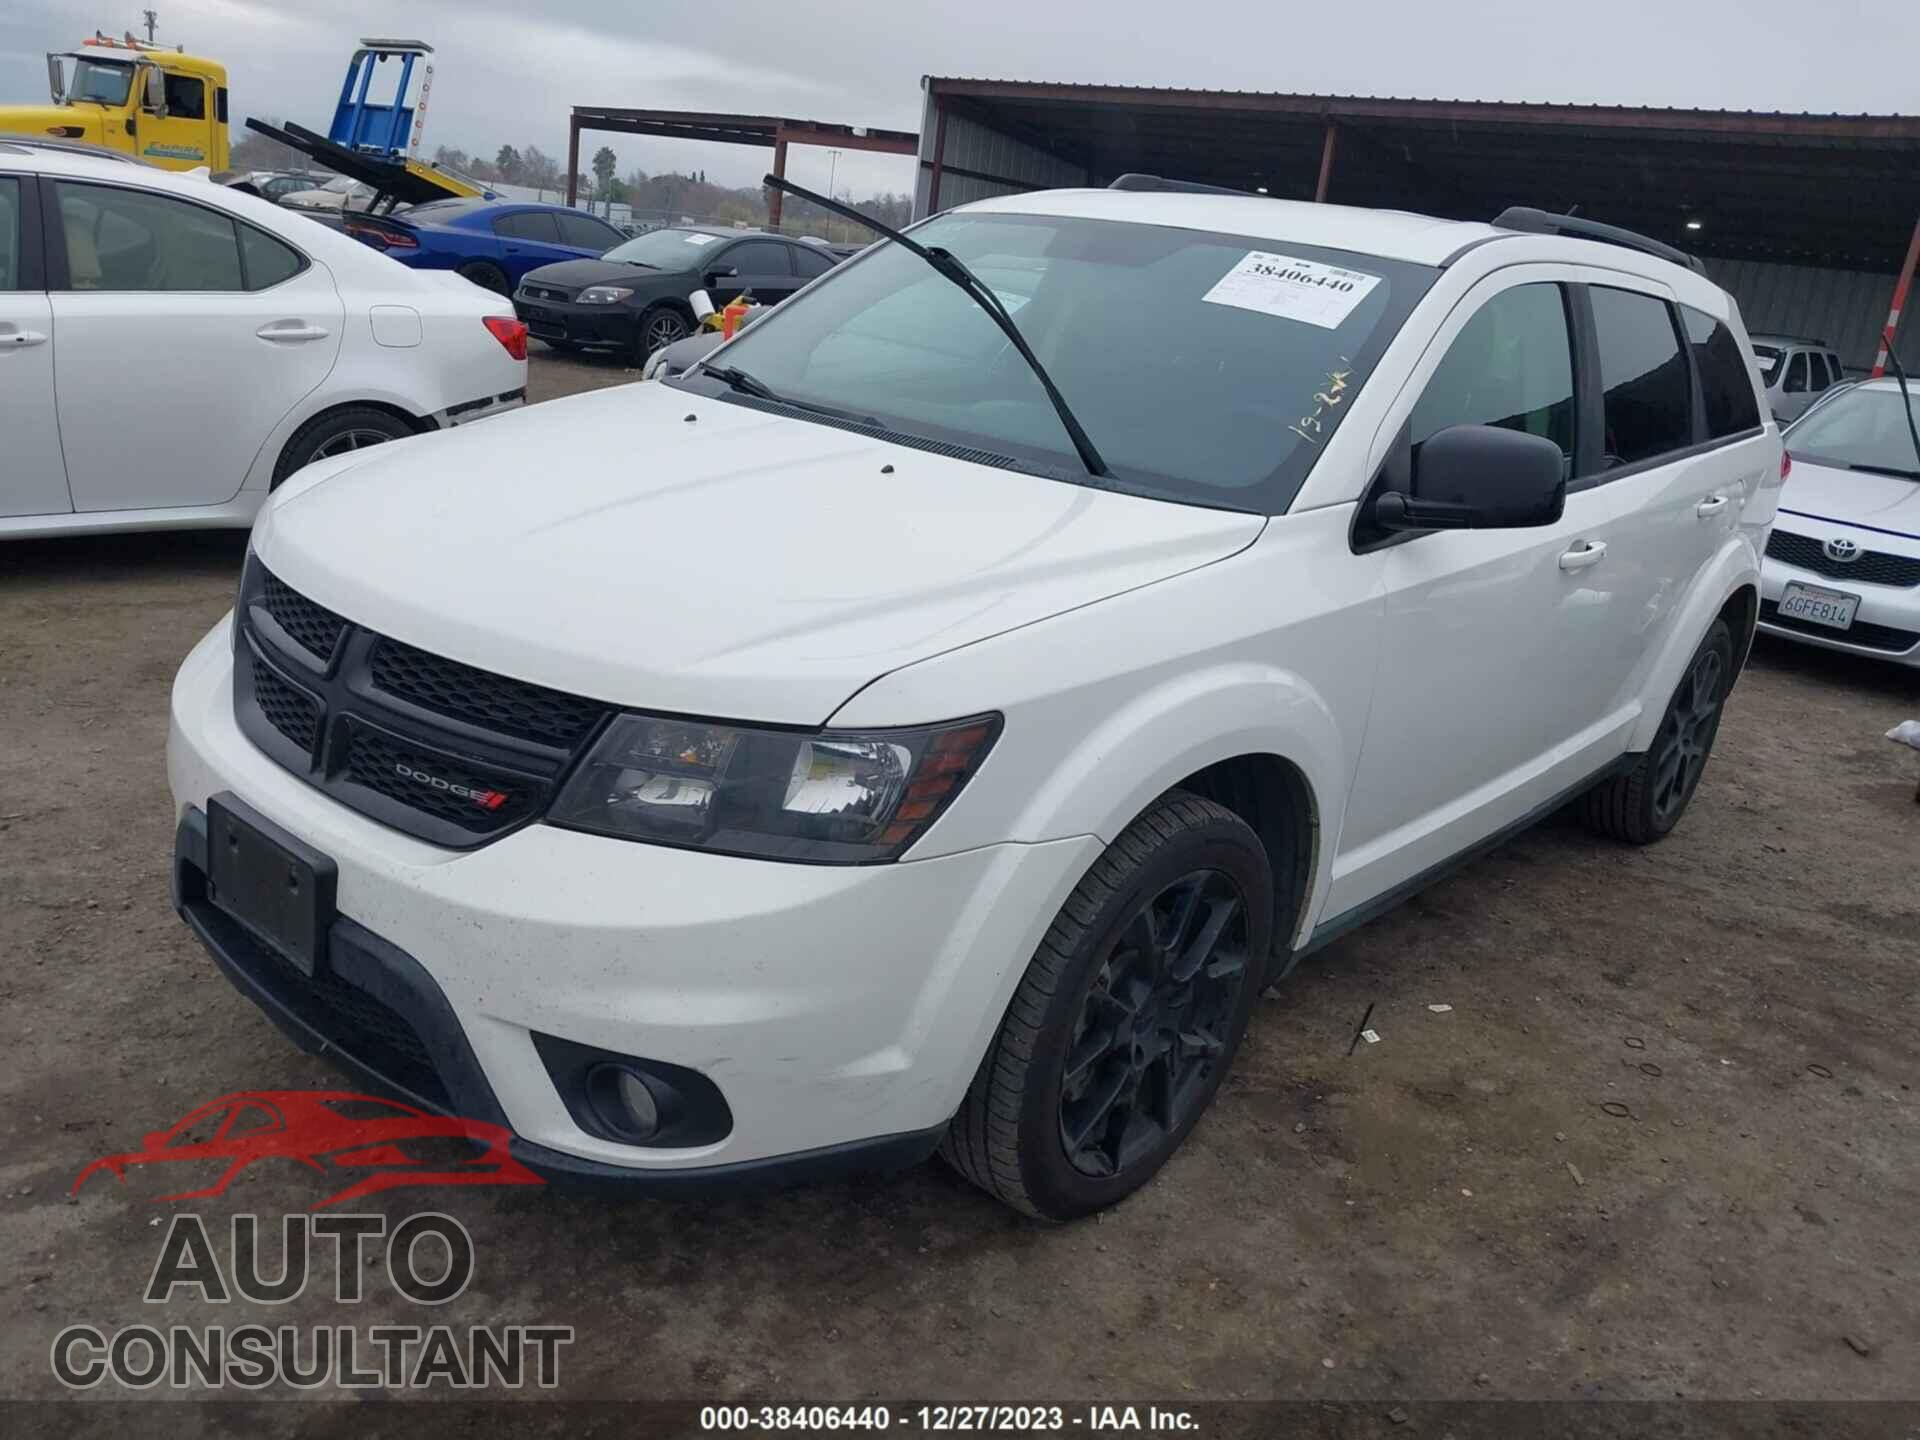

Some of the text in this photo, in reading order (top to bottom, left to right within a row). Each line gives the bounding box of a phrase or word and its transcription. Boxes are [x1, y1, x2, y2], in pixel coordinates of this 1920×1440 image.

[1246, 262, 1355, 293] 38406440
[1785, 596, 1847, 622] 6GFE814
[395, 762, 489, 803] DODGE
